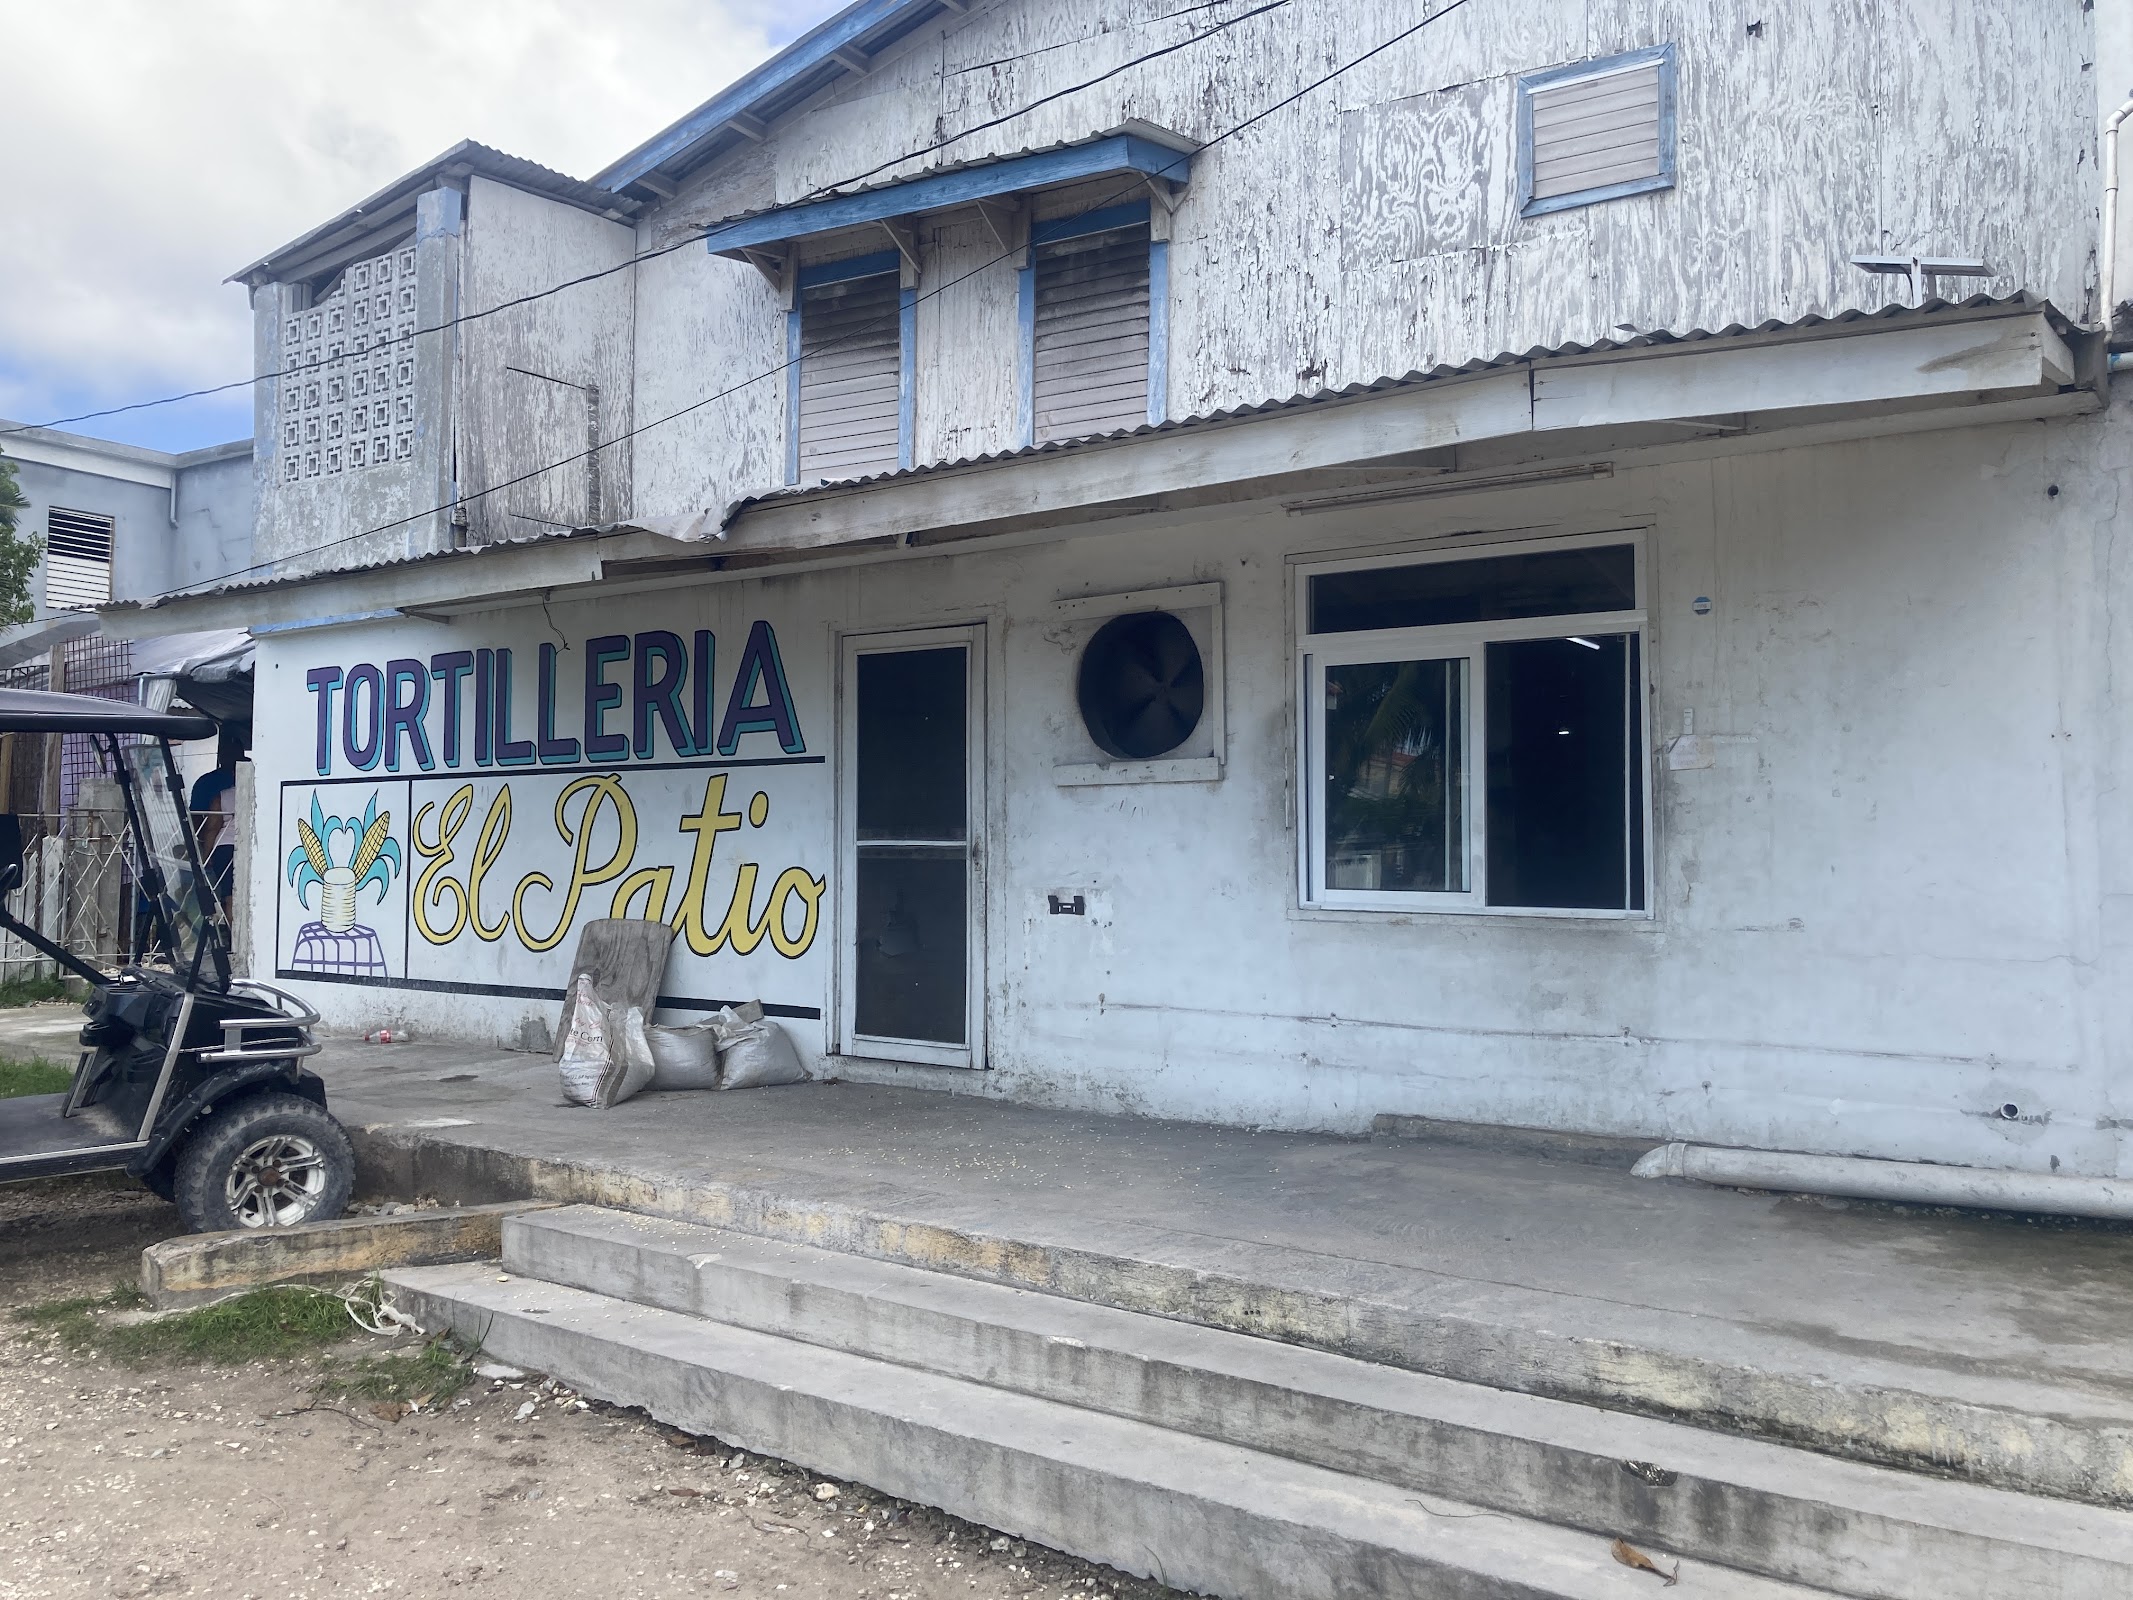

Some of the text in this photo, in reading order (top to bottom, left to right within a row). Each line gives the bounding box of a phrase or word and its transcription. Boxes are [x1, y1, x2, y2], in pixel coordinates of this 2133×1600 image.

[306, 620, 806, 776] TORTILLERIA
[412, 772, 826, 960] El Patio
